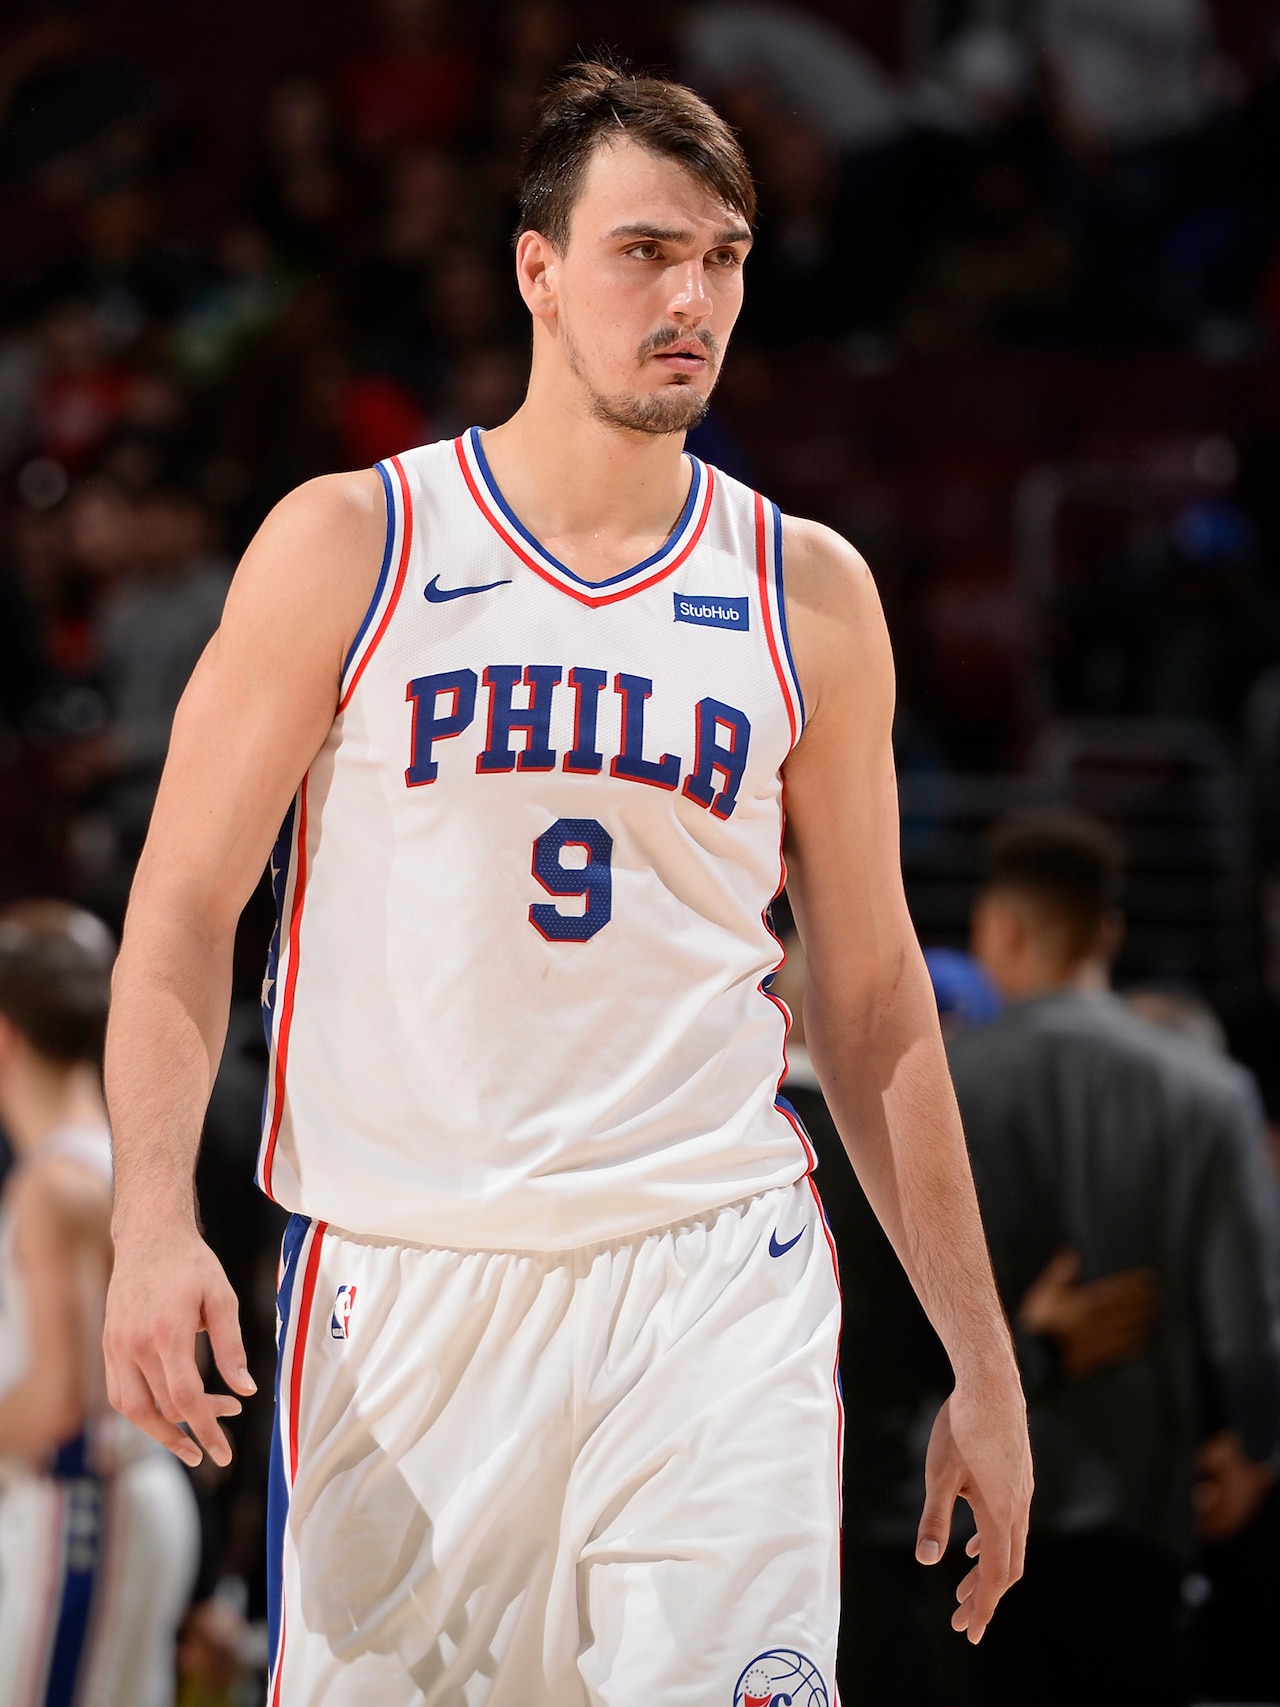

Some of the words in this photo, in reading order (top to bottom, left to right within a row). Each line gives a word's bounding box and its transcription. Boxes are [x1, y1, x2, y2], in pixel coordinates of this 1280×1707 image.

[679, 602, 740, 621] StubHub
[405, 665, 752, 821] PHILA
[528, 818, 615, 943] 9
